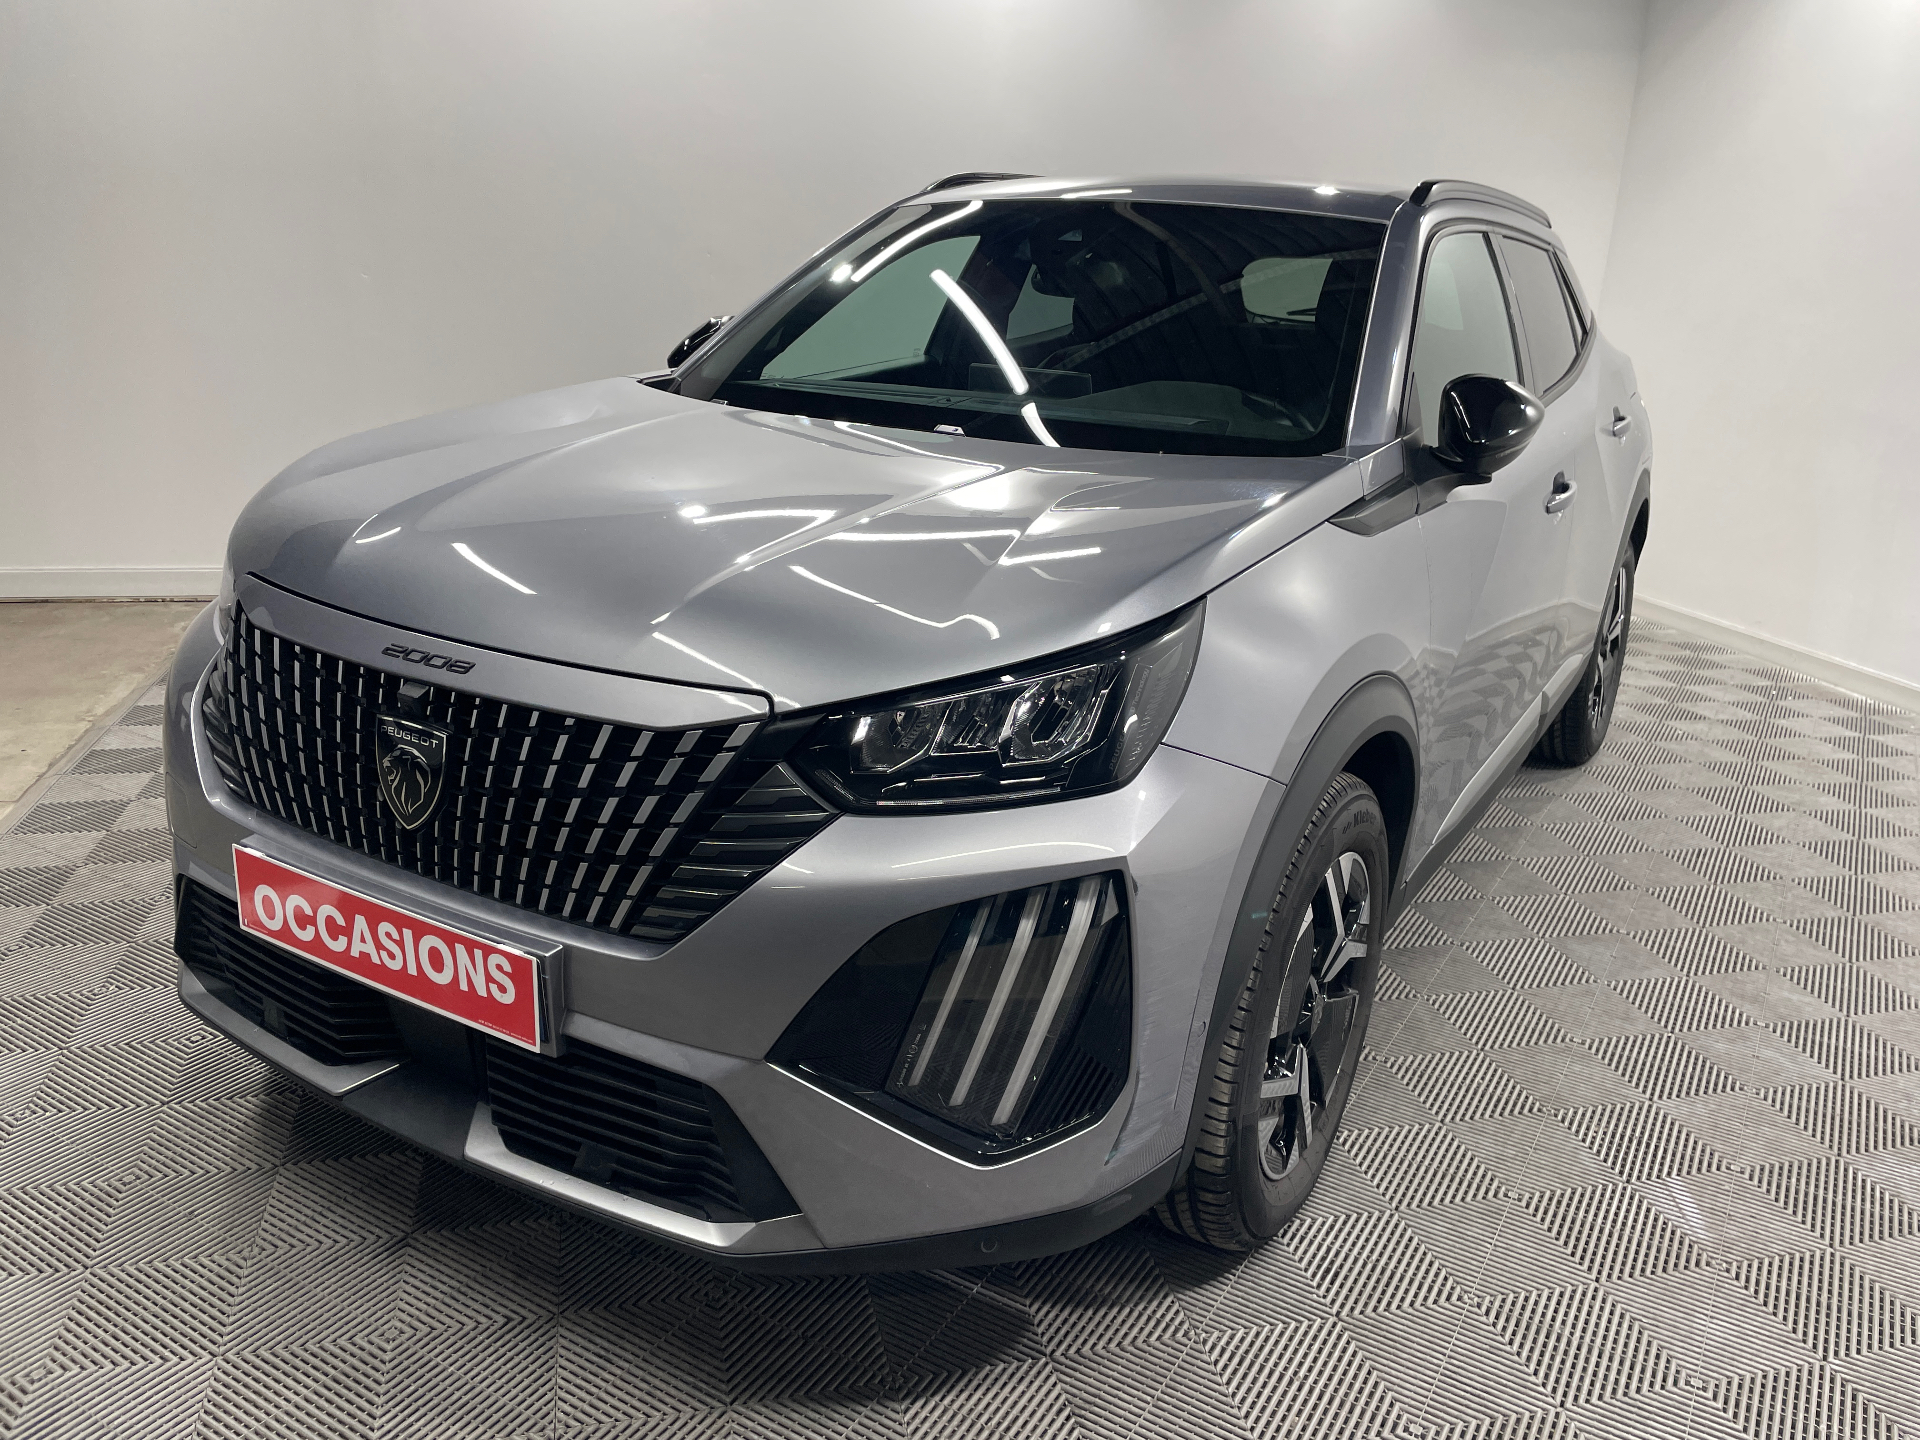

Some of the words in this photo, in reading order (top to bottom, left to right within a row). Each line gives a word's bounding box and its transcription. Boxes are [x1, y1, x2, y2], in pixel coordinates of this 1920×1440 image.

[381, 643, 477, 675] 2008
[380, 725, 439, 749] PEUGEOT
[253, 884, 516, 1005] OCCASIONS
